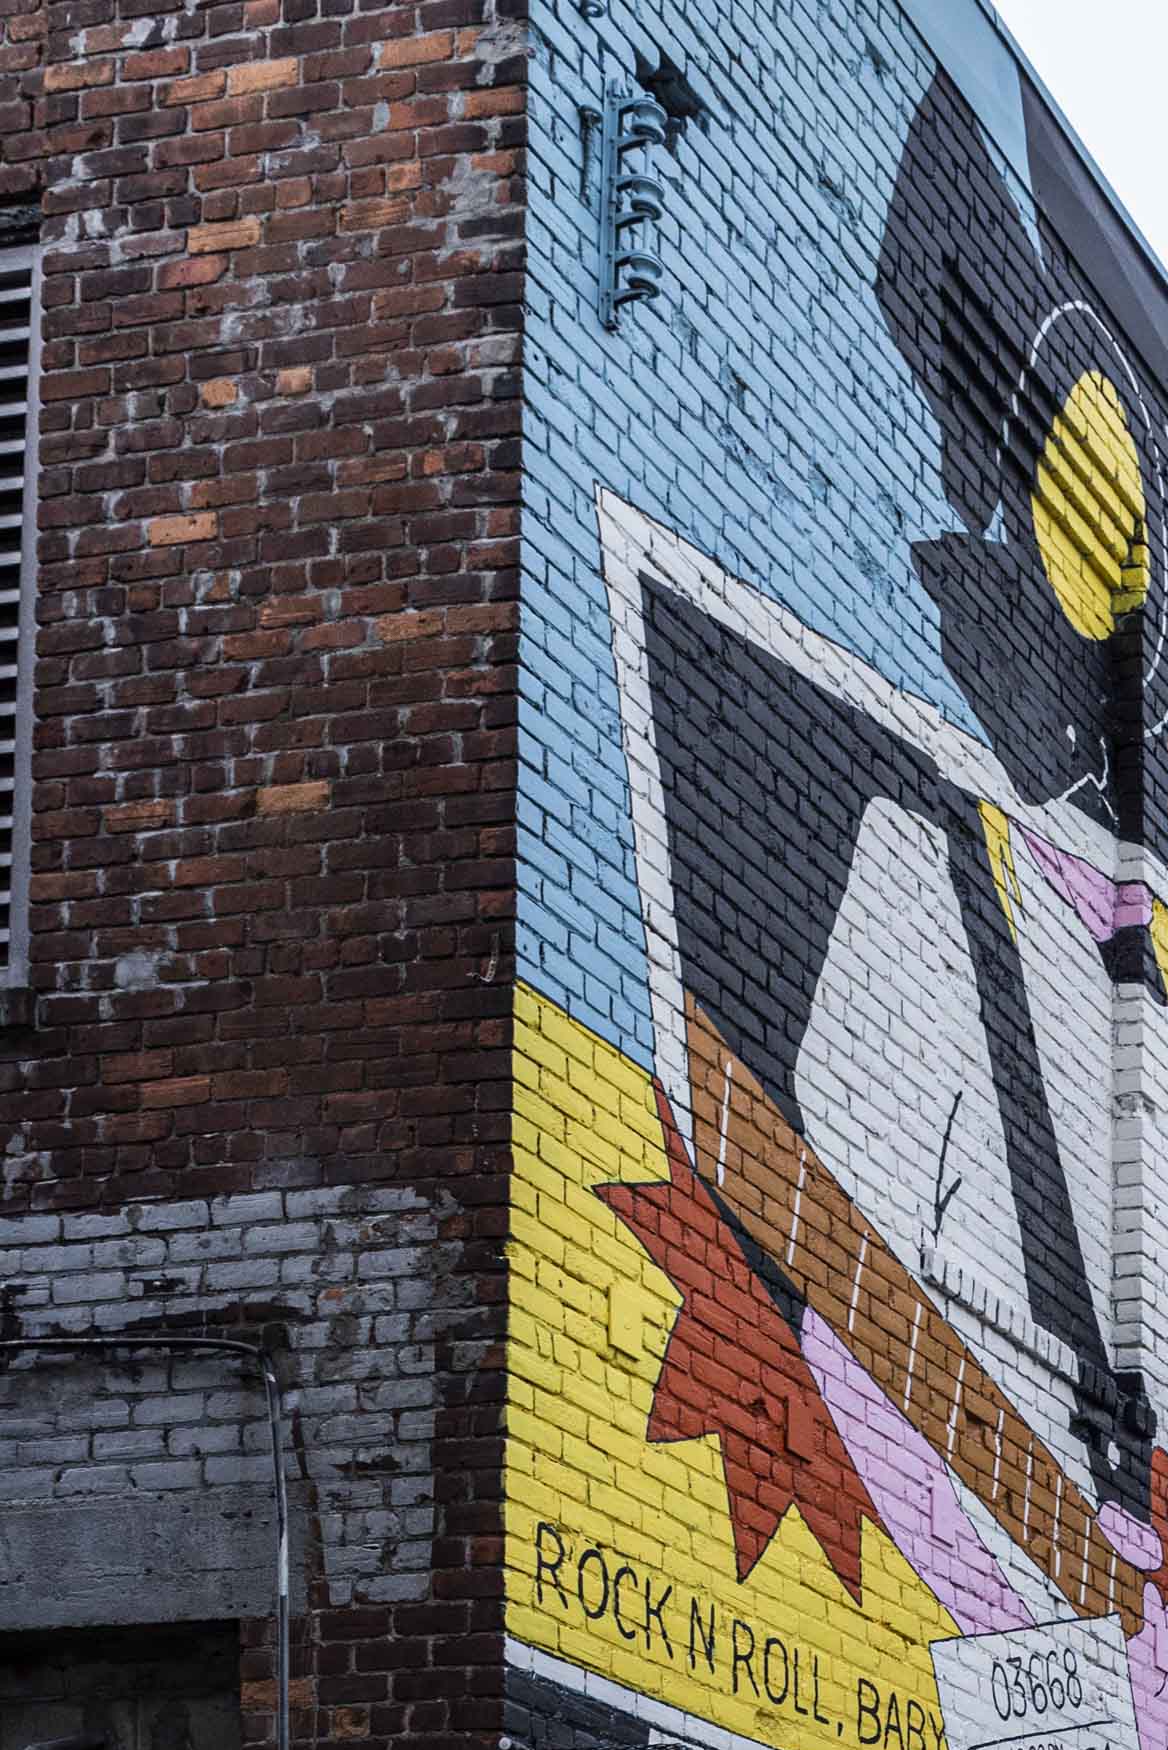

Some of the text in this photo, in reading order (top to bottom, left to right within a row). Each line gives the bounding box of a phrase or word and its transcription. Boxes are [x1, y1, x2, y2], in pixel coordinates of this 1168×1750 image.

[533, 1522, 674, 1660] ROCK
[689, 1598, 716, 1674] N
[731, 1620, 845, 1738] ROLL,
[992, 1648, 1082, 1720] 03668
